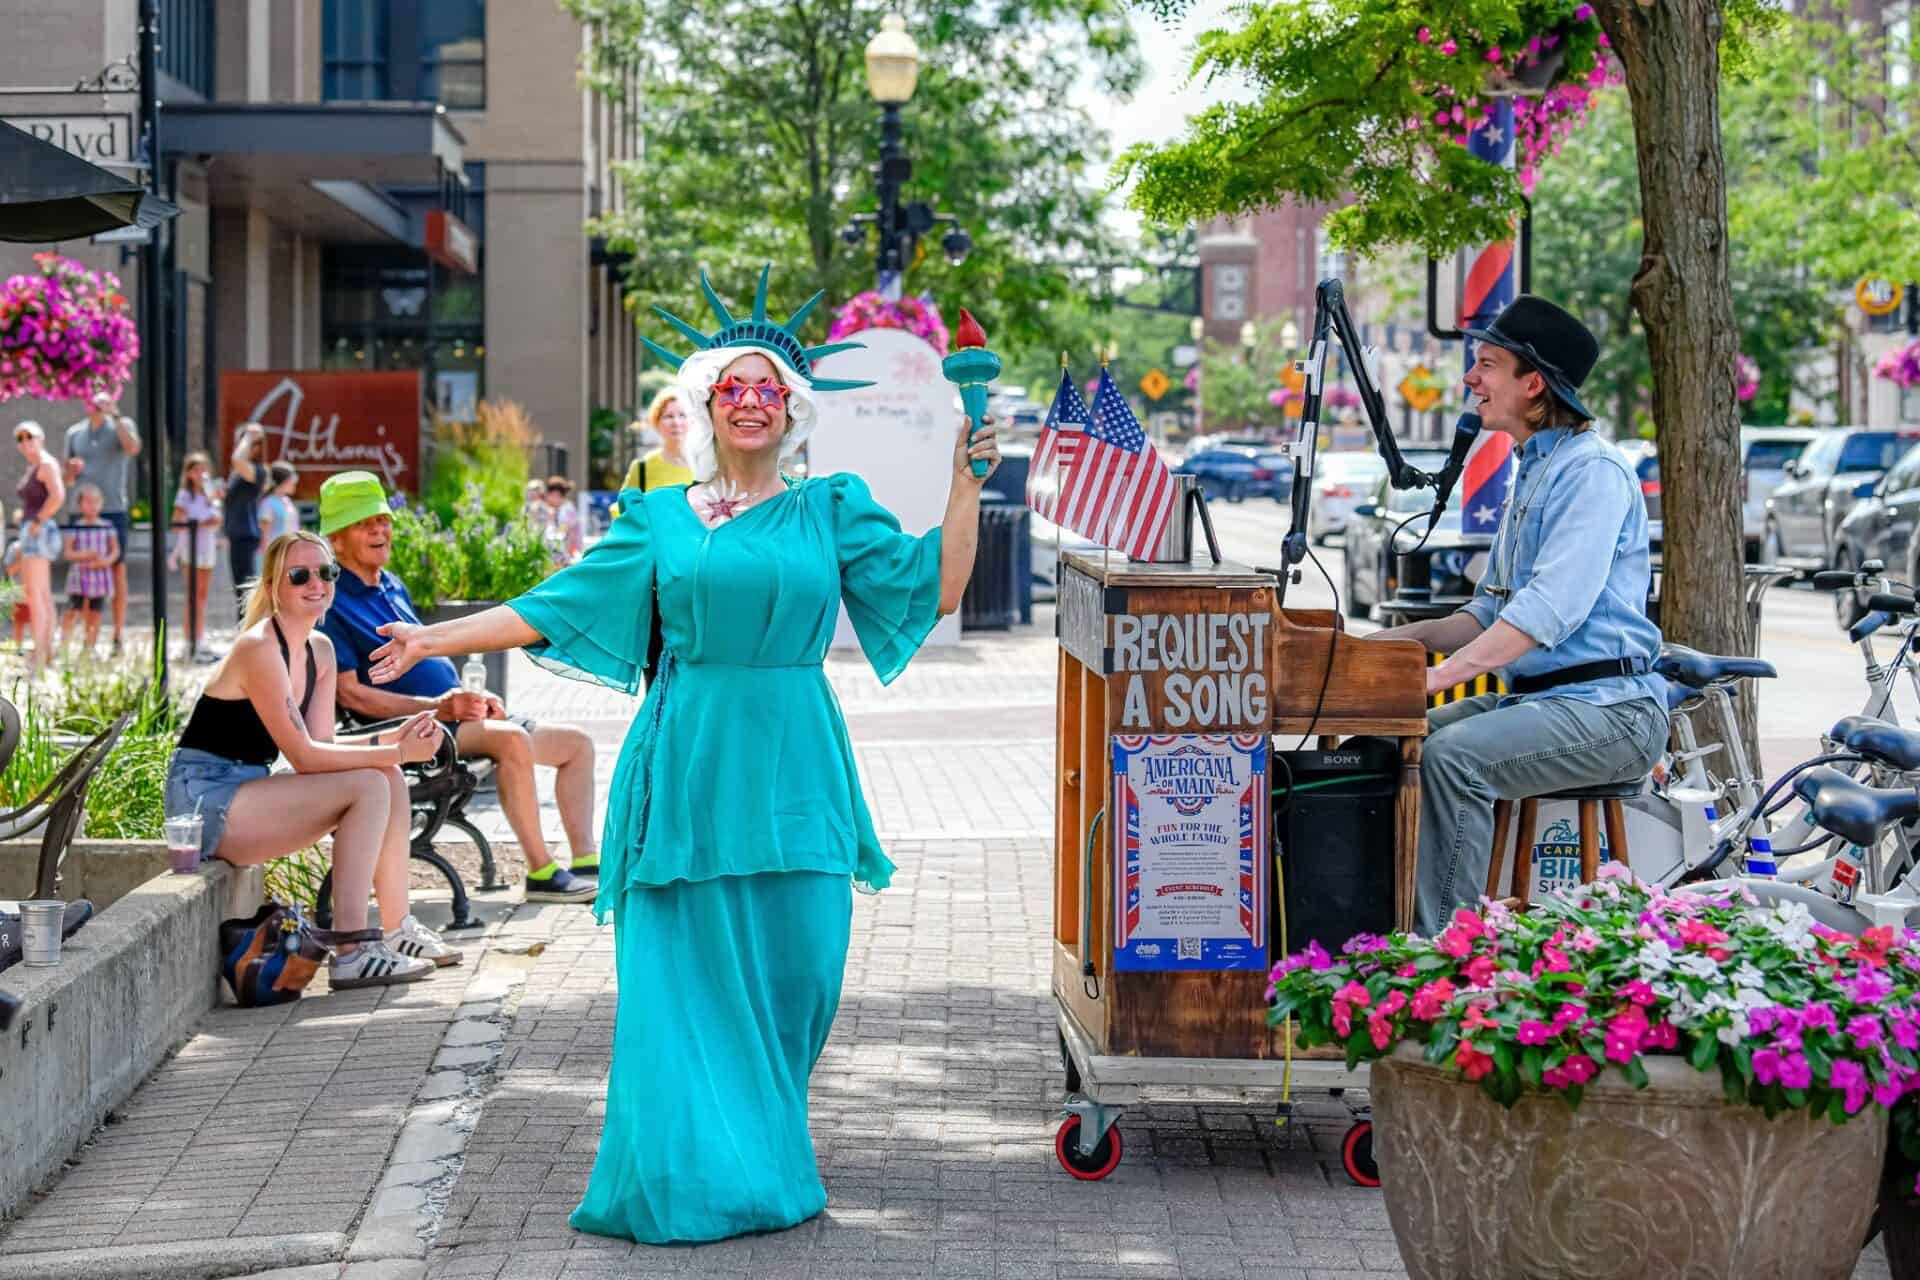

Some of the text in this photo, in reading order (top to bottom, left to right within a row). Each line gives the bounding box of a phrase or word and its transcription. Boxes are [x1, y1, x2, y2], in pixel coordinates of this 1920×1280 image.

[238, 376, 409, 489] Anthony's
[1113, 612, 1271, 672] REQUEST
[1122, 672, 1268, 728] A SONG
[1323, 755, 1361, 764] SONY
[1141, 756, 1240, 786] AMERICANA
[1161, 779, 1174, 788] ON
[1175, 778, 1216, 795] MAIN
[1157, 822, 1224, 833] FUN FOR THE
[1151, 832, 1231, 845] WHOLE FAMILY
[1543, 846, 1582, 856] CAR
[1540, 859, 1582, 880] BIK
